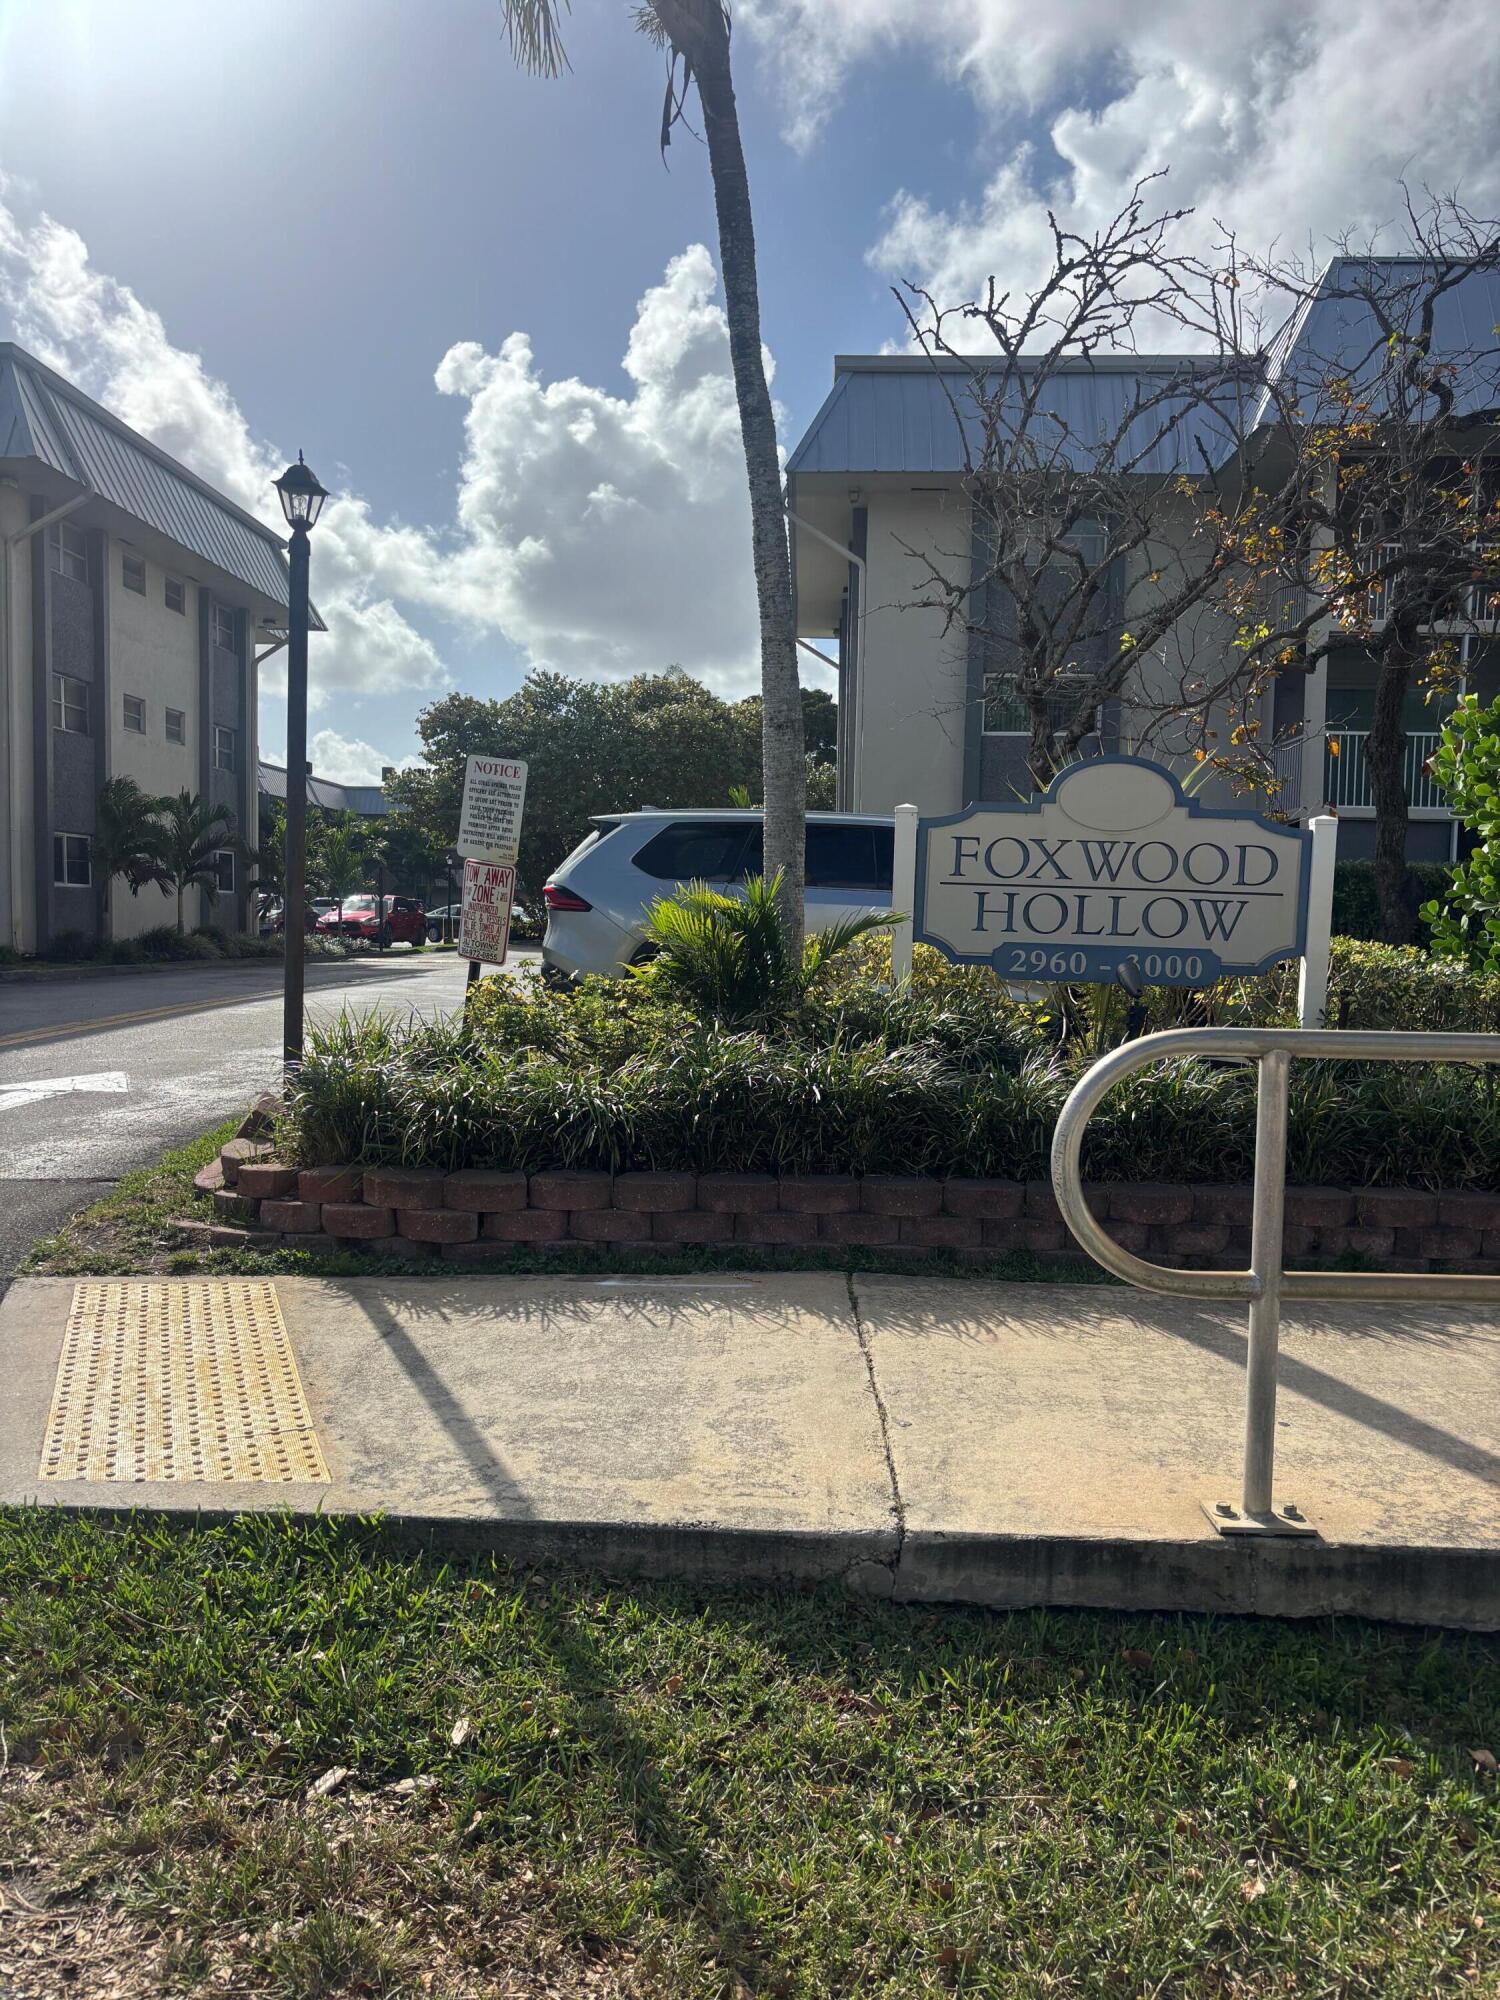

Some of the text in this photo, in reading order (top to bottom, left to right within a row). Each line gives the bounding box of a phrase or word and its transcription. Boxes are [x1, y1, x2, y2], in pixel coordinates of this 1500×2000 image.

[474, 761, 521, 779] NOTICE
[948, 836, 1279, 887] FOXWOOD
[466, 864, 511, 888] TOW AWAY
[472, 884, 496, 905] ZONE
[972, 891, 1249, 942] HOLLOW
[471, 939, 499, 951] TOWING
[1009, 950, 1087, 975] 2960
